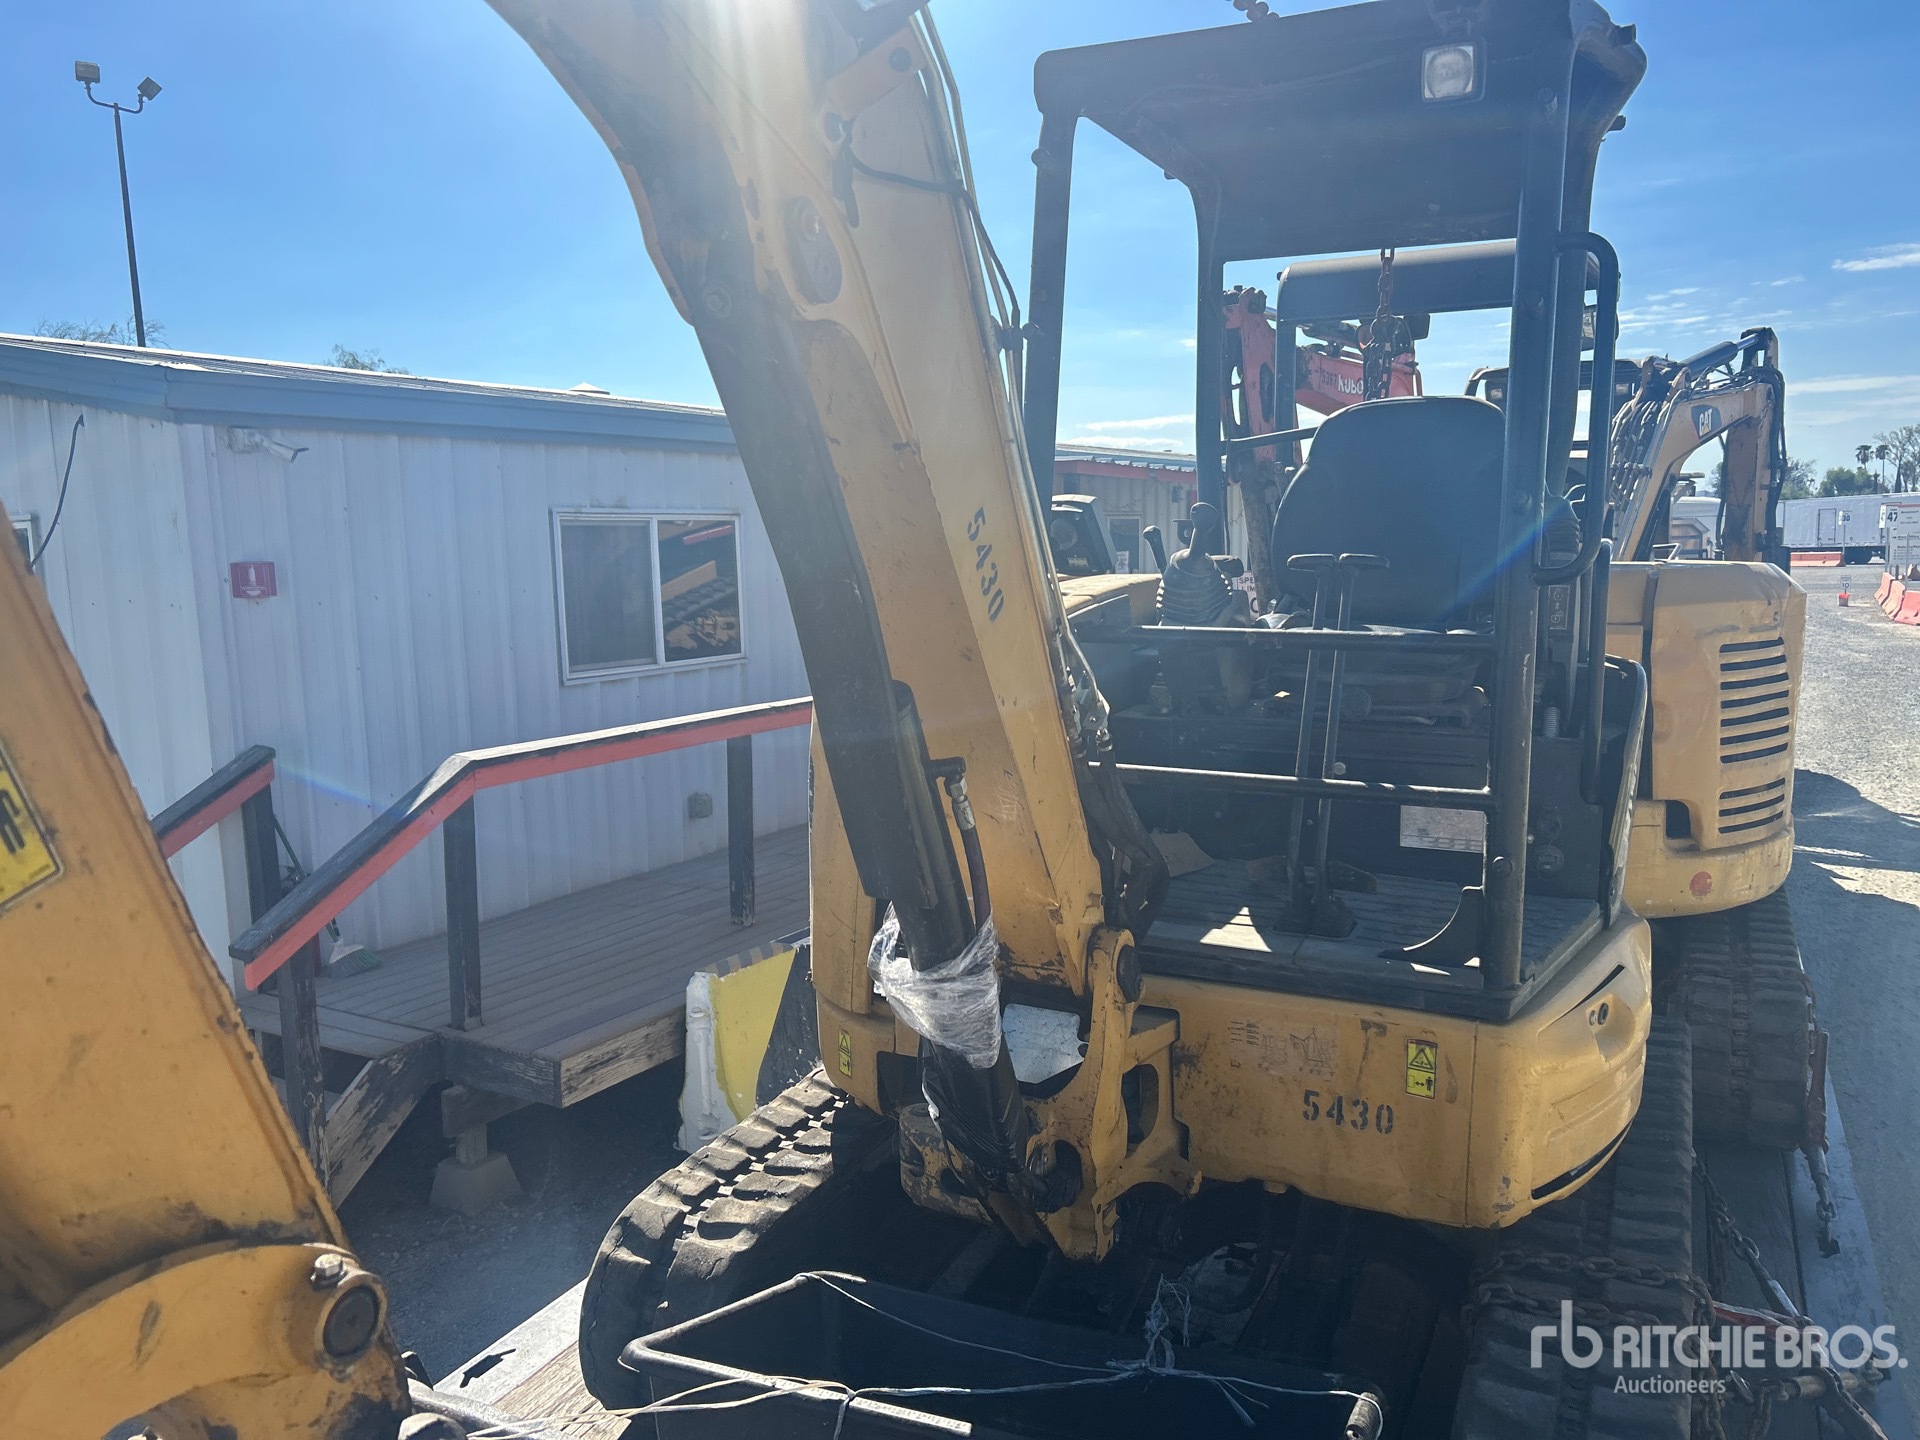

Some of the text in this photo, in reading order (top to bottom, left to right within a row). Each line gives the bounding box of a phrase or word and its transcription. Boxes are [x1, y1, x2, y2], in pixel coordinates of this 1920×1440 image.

[1699, 408, 1713, 436] CAT
[1886, 512, 1898, 522] 47
[967, 507, 1004, 622] 5430
[1303, 1089, 1394, 1135] 5430
